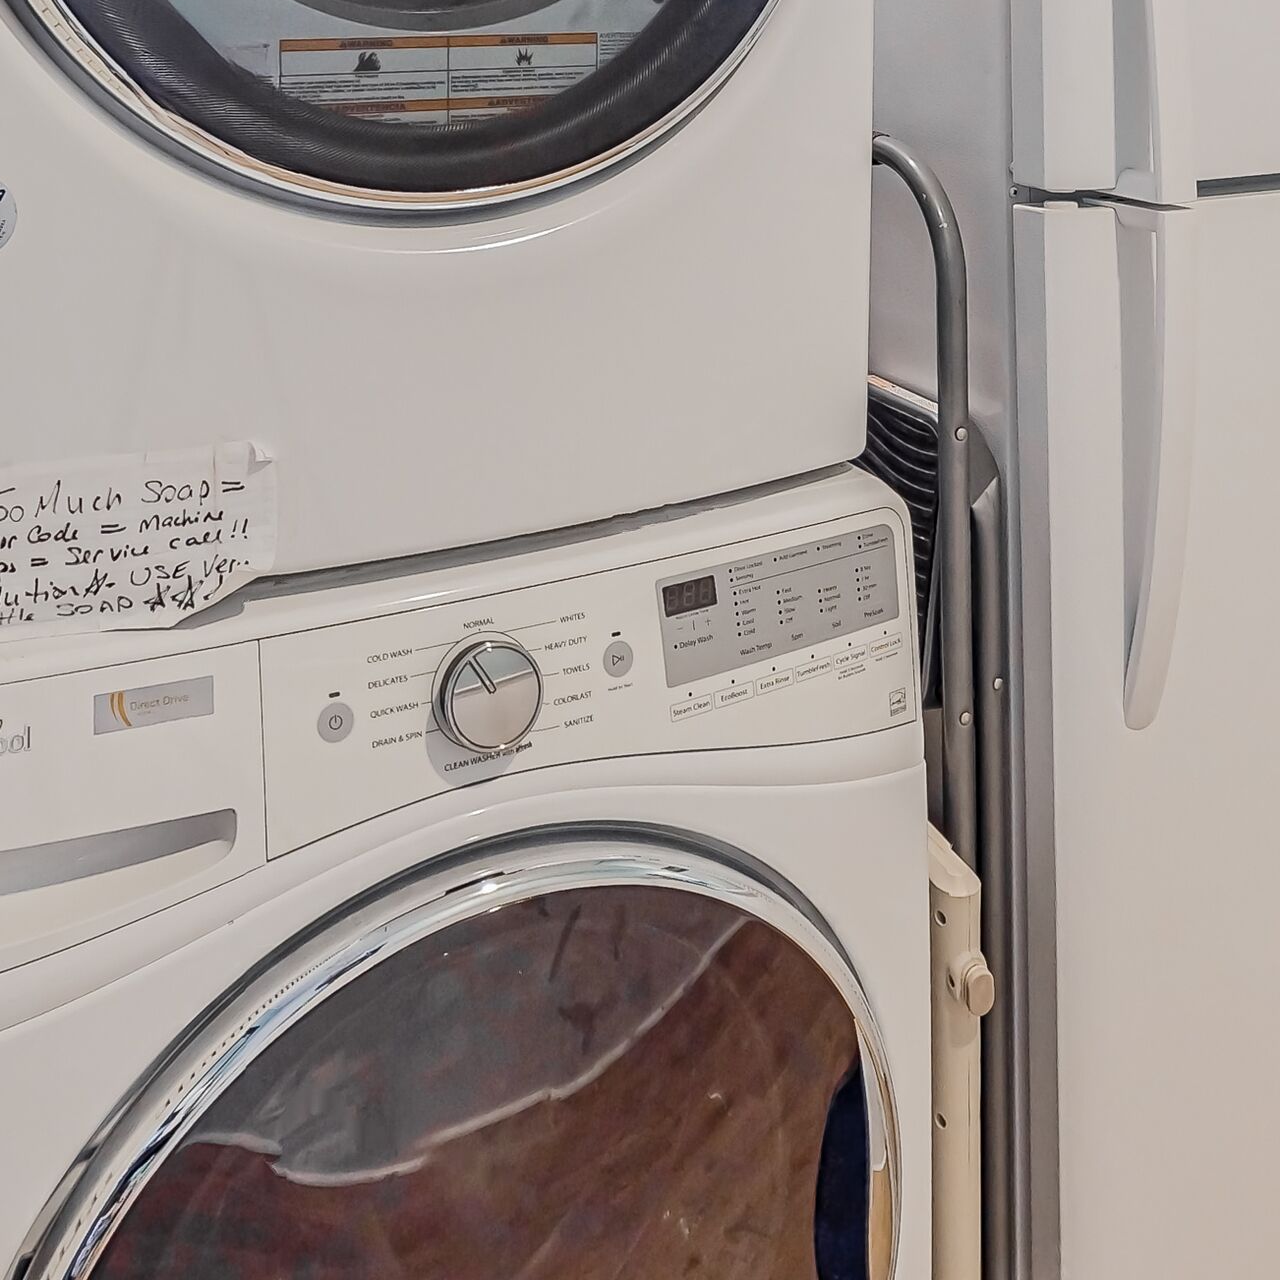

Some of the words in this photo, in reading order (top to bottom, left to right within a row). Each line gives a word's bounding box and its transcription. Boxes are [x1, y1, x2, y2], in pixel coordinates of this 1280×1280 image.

[34, 479, 122, 518] Much
[140, 479, 210, 505] Soap
[26, 522, 79, 544] Code
[129, 559, 191, 587] USE
[463, 616, 495, 630] NORMAL
[559, 612, 586, 624] WHITES
[544, 641, 568, 652] HEAVY
[568, 635, 588, 646] DUTY
[678, 638, 697, 649] Delay
[696, 634, 714, 644] Wash
[366, 651, 389, 664] COLD
[389, 648, 413, 659] WASH
[562, 663, 591, 676] TOWELS
[367, 674, 409, 690] DELICATES
[129, 698, 161, 712] Direct
[162, 694, 190, 706] Drive
[552, 690, 593, 707] COLORLAST
[720, 689, 748, 703] EcoBoost
[369, 706, 395, 719] QUICK
[395, 701, 419, 713] WASH
[672, 705, 693, 718] Steam
[693, 700, 711, 711] Clean
[563, 713, 594, 729] SANITIZE
[371, 736, 397, 749] DRAIN
[405, 730, 423, 742] SPIN
[443, 759, 469, 772] CLEAN
[470, 750, 501, 765] WASHER
